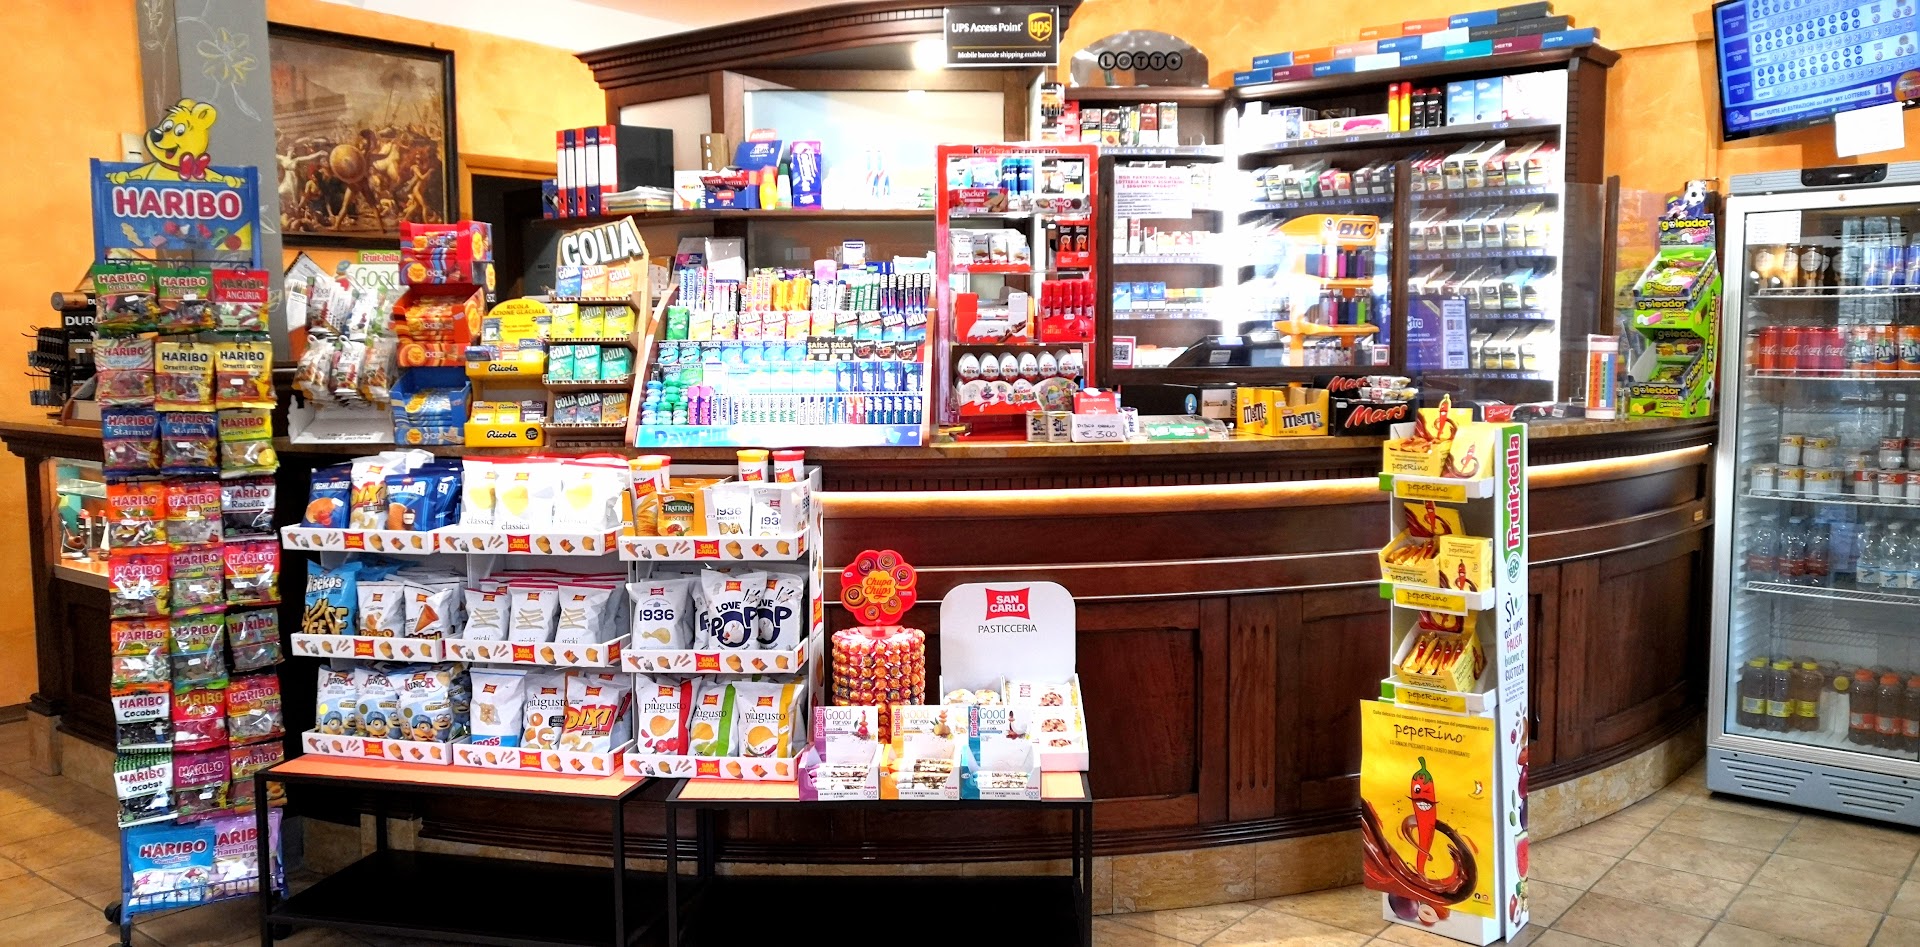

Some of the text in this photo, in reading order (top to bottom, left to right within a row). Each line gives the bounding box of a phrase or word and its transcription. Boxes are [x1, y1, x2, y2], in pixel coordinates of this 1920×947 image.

[951, 22, 1022, 33] UPS Access Point
[1030, 19, 1051, 40] ups
[957, 51, 977, 59] Mobile
[1000, 51, 1023, 60] shipping
[1844, 90, 1871, 100] LOTTERIES
[114, 188, 241, 219] HARIBO
[1339, 223, 1373, 236] BIC
[1662, 219, 1711, 231] goleador
[98, 273, 148, 284] HARIBO
[160, 276, 208, 287] HARIBO
[226, 290, 260, 300] ANGURIA
[1638, 300, 1686, 310] goleador
[65, 316, 97, 326] DUR
[1707, 291, 1716, 374] goleador
[103, 347, 144, 357] HARIBO
[161, 351, 208, 362] HARIBO
[220, 351, 265, 361] HARIBO
[488, 363, 519, 372] Ricola
[1633, 385, 1681, 397] goleador
[107, 415, 155, 426] HARIBO
[1345, 405, 1408, 428] Mars
[221, 417, 264, 428] HARIBO
[113, 428, 150, 436] Starmix
[487, 430, 517, 438] Ricola
[228, 488, 269, 498] HARIBO
[1507, 434, 1520, 550] Fruit-tella
[112, 496, 157, 506] HARIBO
[169, 494, 214, 505] HARIBO
[231, 500, 265, 508] Rotella
[664, 504, 694, 512] TRATTORIA
[716, 507, 742, 516] 1936
[501, 522, 530, 531] classica
[174, 554, 218, 565] HARIBO
[115, 565, 162, 577] HARIBO
[866, 577, 892, 588] Chupa
[864, 586, 892, 599] Chups
[996, 595, 1019, 604] SAN
[716, 601, 742, 613] LOVE
[989, 603, 1026, 613] CARLO
[639, 609, 674, 621] 1936
[978, 624, 1038, 634] PASTICCERIA
[117, 630, 162, 640] HARIBO
[230, 688, 274, 702] HARIBO
[119, 696, 164, 708] HARIBO
[123, 709, 161, 718] Cocobat
[565, 708, 612, 729] DIXI
[825, 709, 851, 720] Good
[904, 709, 929, 719] Good
[980, 708, 1006, 719] Good
[1394, 723, 1463, 744] pepeRino
[178, 761, 224, 777] HARIBO
[119, 768, 165, 784] HARIBO
[126, 781, 163, 792] Cocobat
[140, 840, 206, 857] HARIBO
